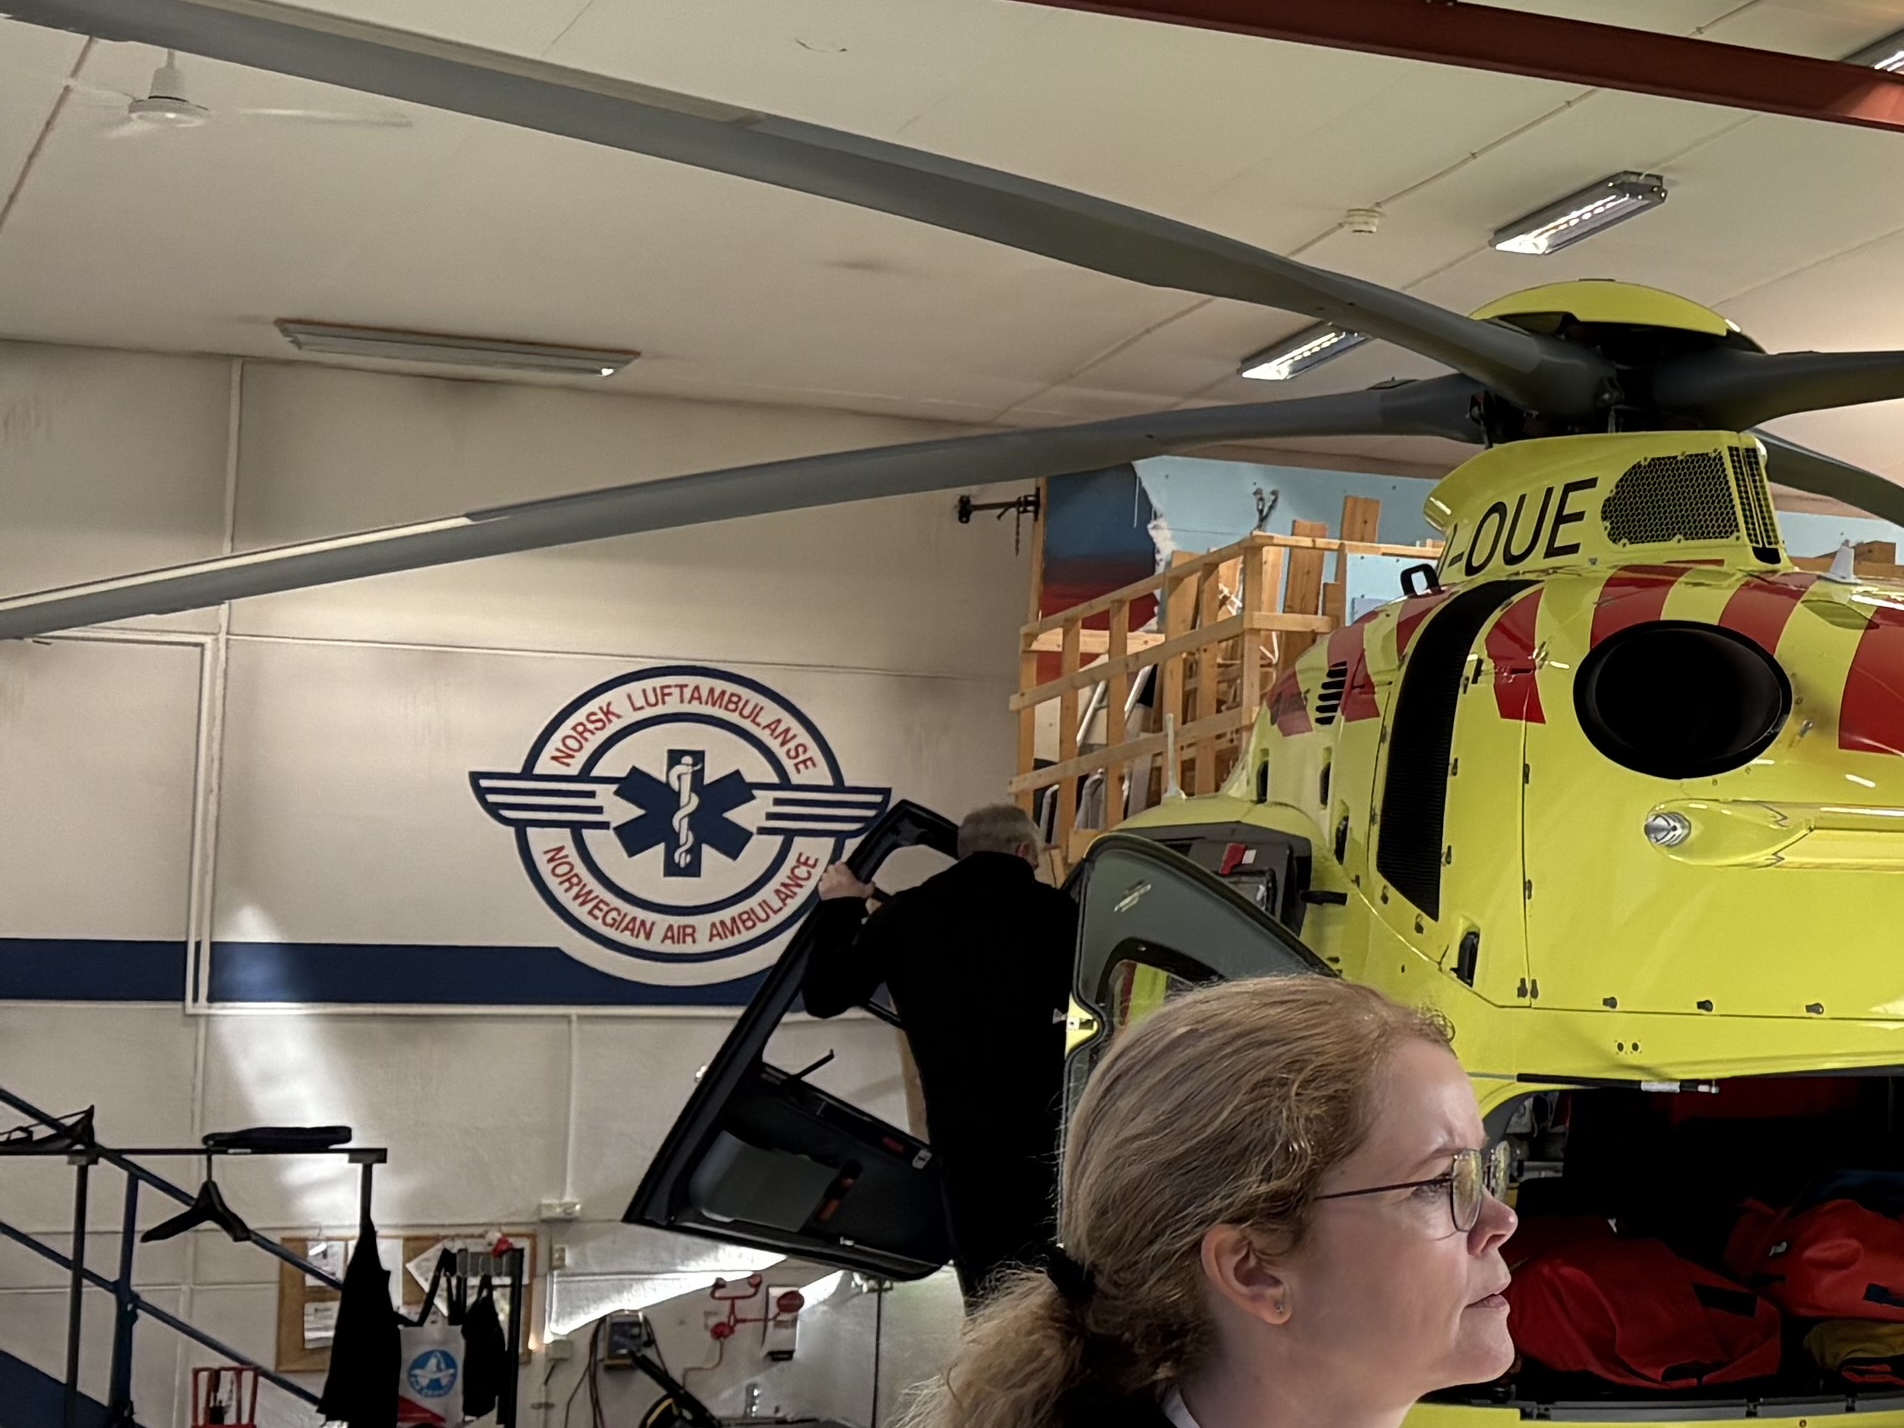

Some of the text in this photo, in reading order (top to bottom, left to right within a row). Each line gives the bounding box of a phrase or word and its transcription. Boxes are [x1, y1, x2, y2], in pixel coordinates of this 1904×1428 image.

[550, 684, 817, 775] NORSK LUFTAMBULANSE
[543, 845, 819, 945] NORWEGIAN AIR AMBULANCE
